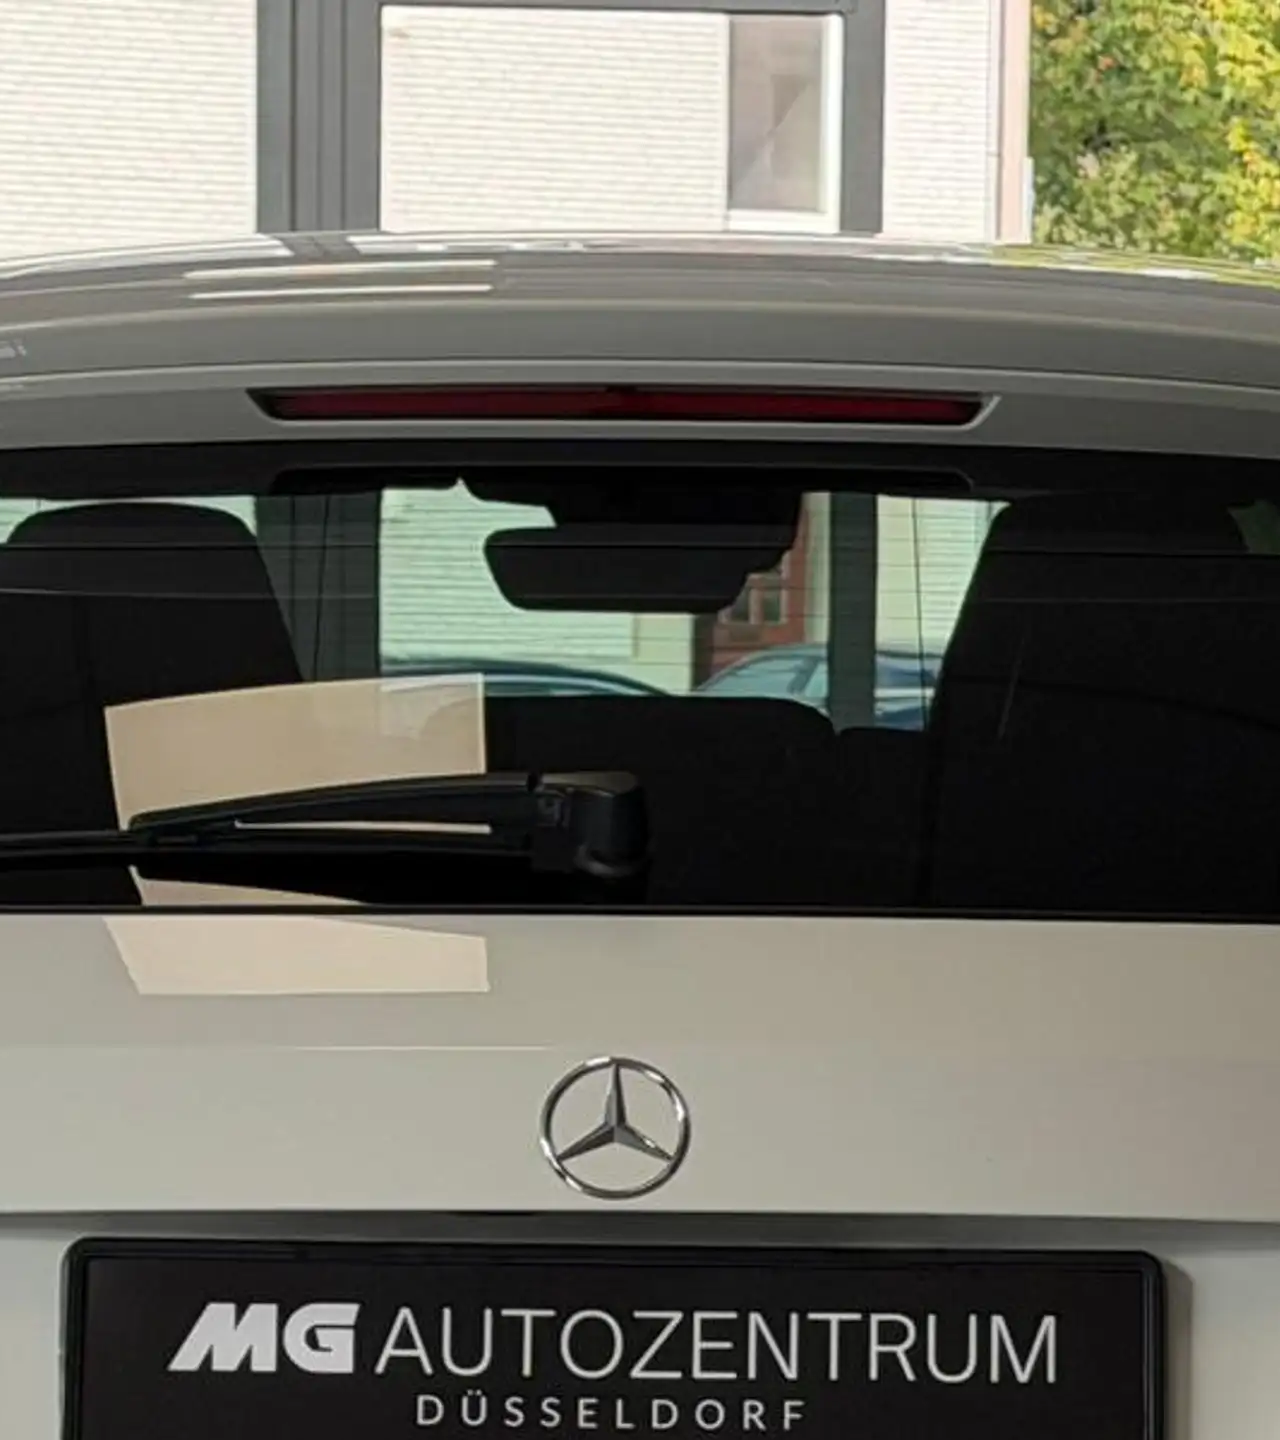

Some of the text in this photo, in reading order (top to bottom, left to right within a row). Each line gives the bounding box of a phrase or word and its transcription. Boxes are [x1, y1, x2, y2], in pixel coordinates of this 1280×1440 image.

[168, 1302, 1057, 1384] MG AUTOZENTRUM
[416, 1389, 805, 1431] DÜSSELDORF
